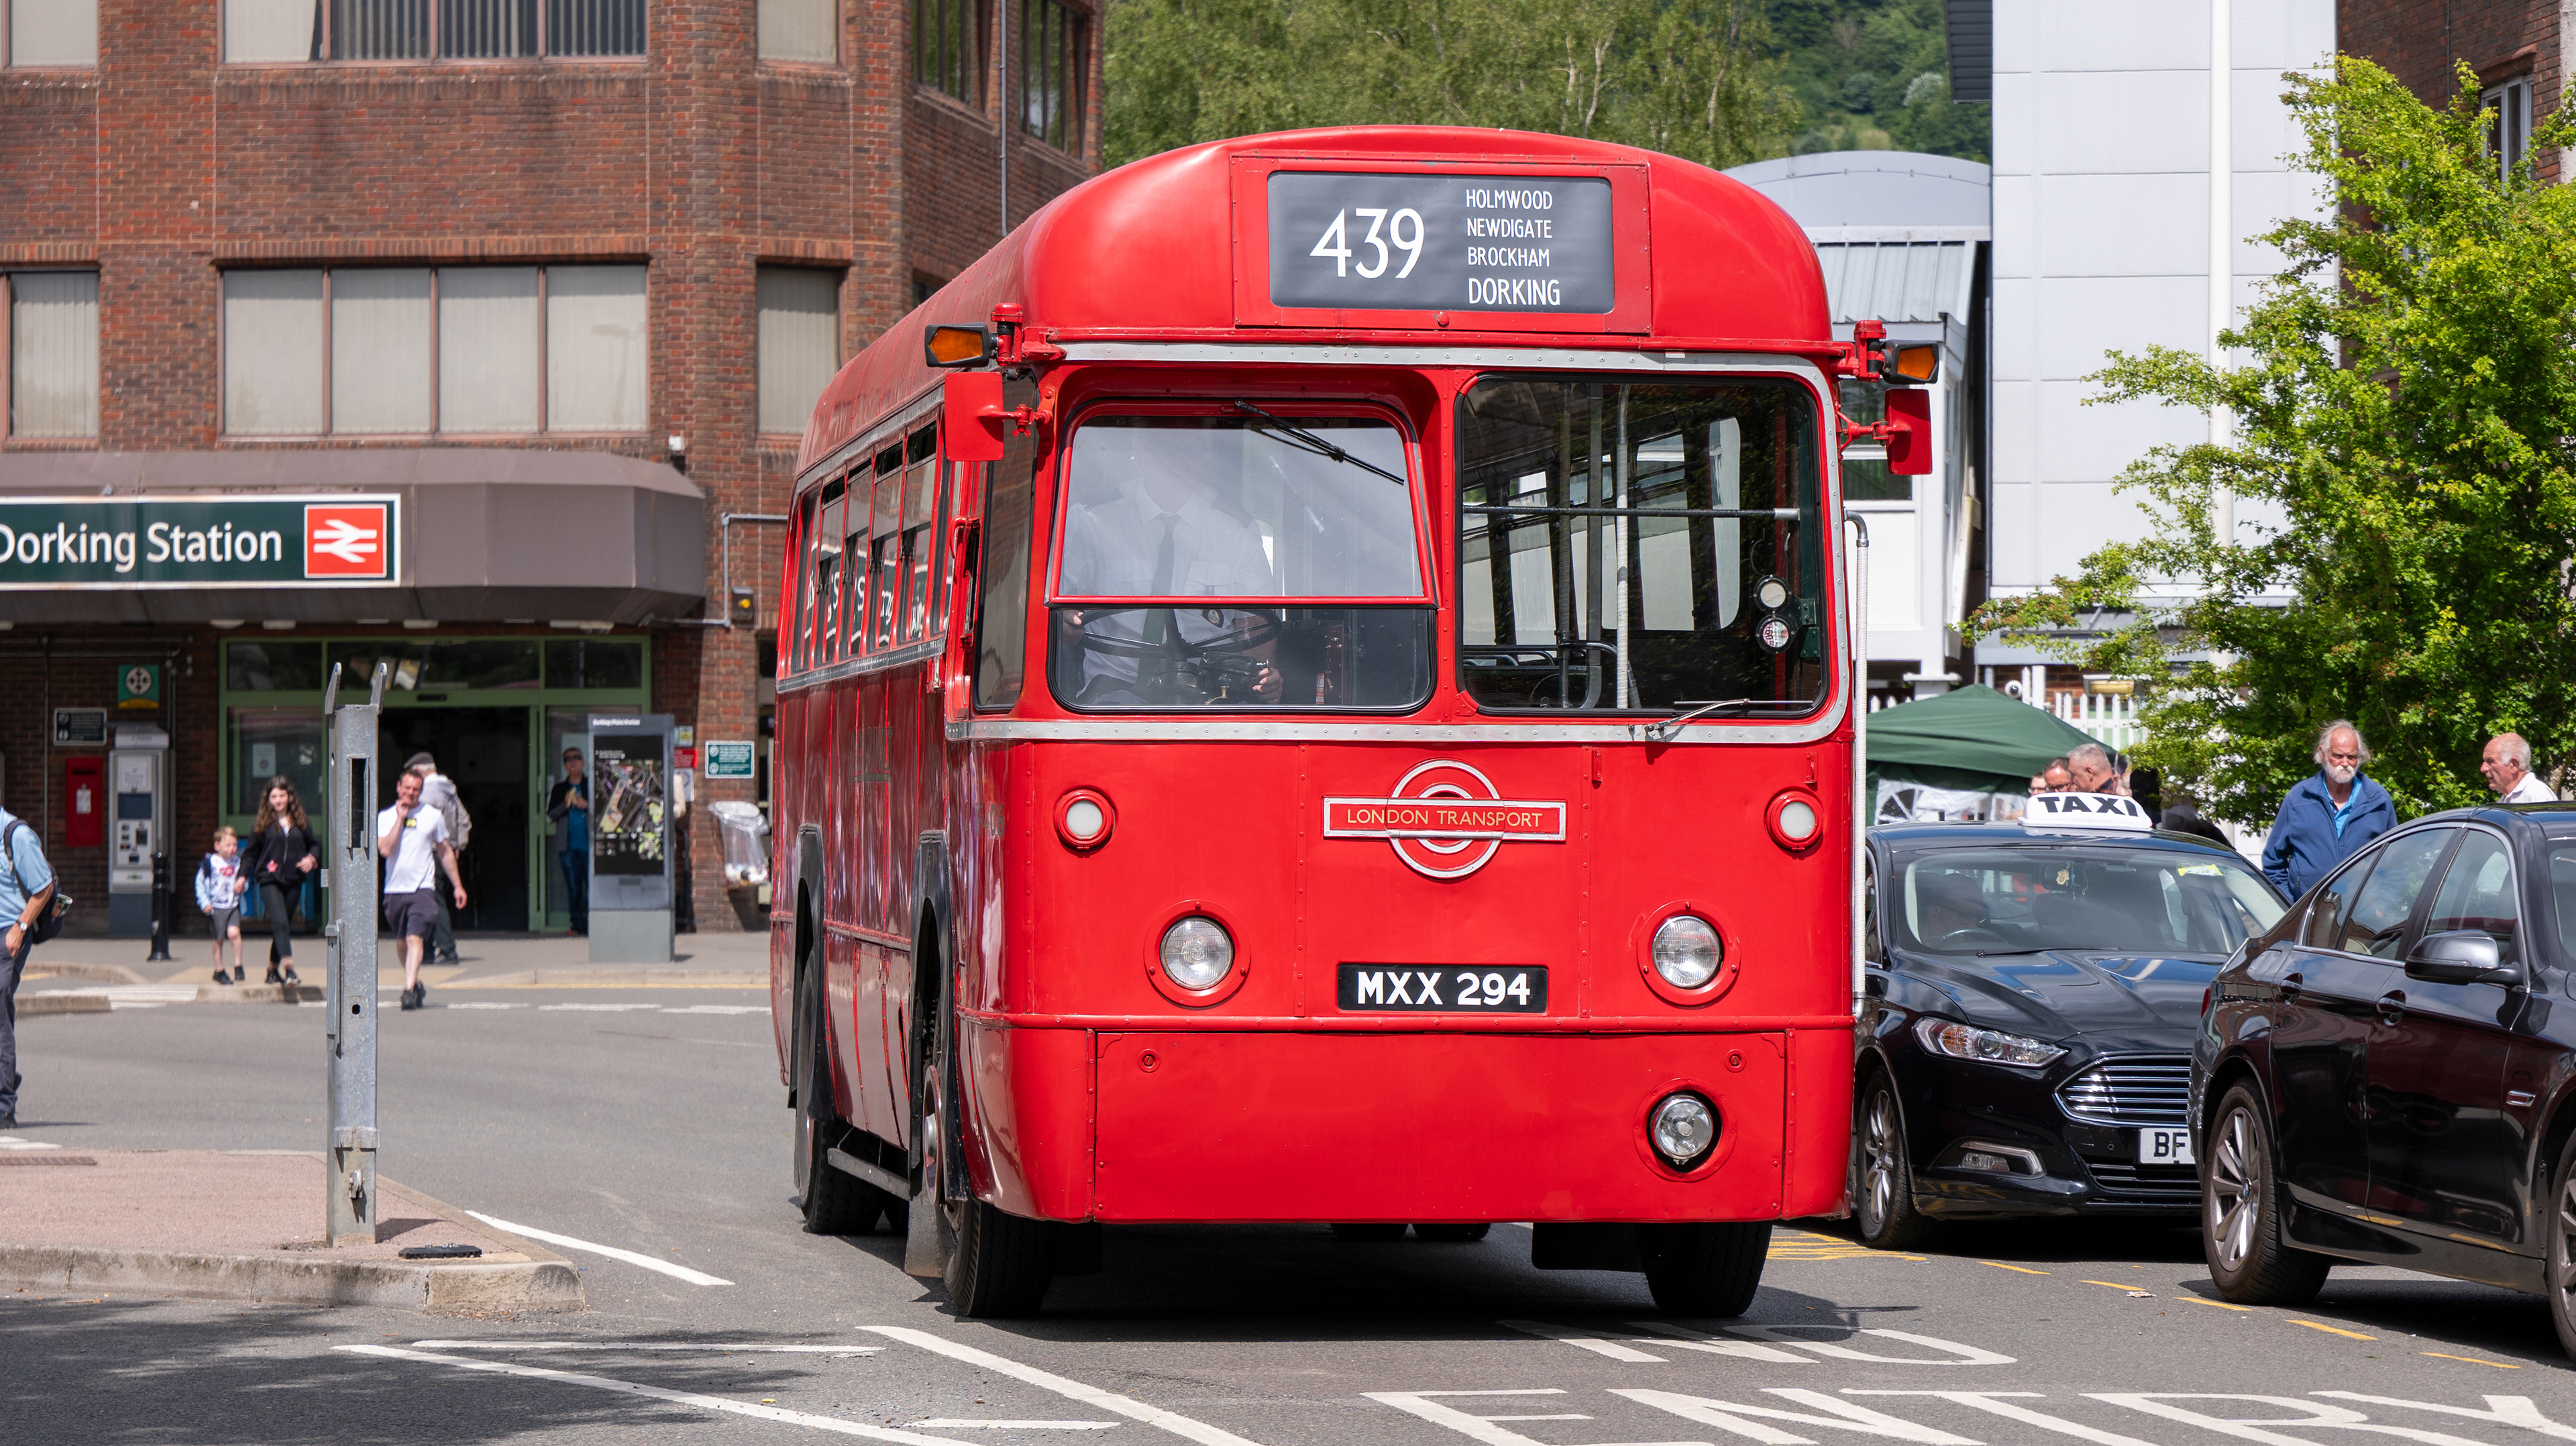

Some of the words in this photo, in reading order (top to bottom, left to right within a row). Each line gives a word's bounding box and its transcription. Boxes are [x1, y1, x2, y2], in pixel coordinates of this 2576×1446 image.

[1466, 188, 1553, 210] HOLMWOOD
[1466, 218, 1552, 239] NEWDIGATE
[1309, 207, 1425, 279] 439
[1467, 246, 1550, 267] BROCKHAM
[1468, 278, 1560, 306] DORKING
[0, 522, 136, 573] Dorking
[146, 521, 282, 563] Station
[1347, 809, 1429, 825] LONDON
[1437, 810, 1542, 828] TRANSPORT
[2037, 795, 2139, 817] TAXI
[1358, 971, 1443, 1005] MXX
[1456, 972, 1530, 1005] 294
[2153, 1131, 2188, 1158] BF
[1495, 1319, 2018, 1366] NO
[1359, 1388, 2576, 1446] ENTRY
